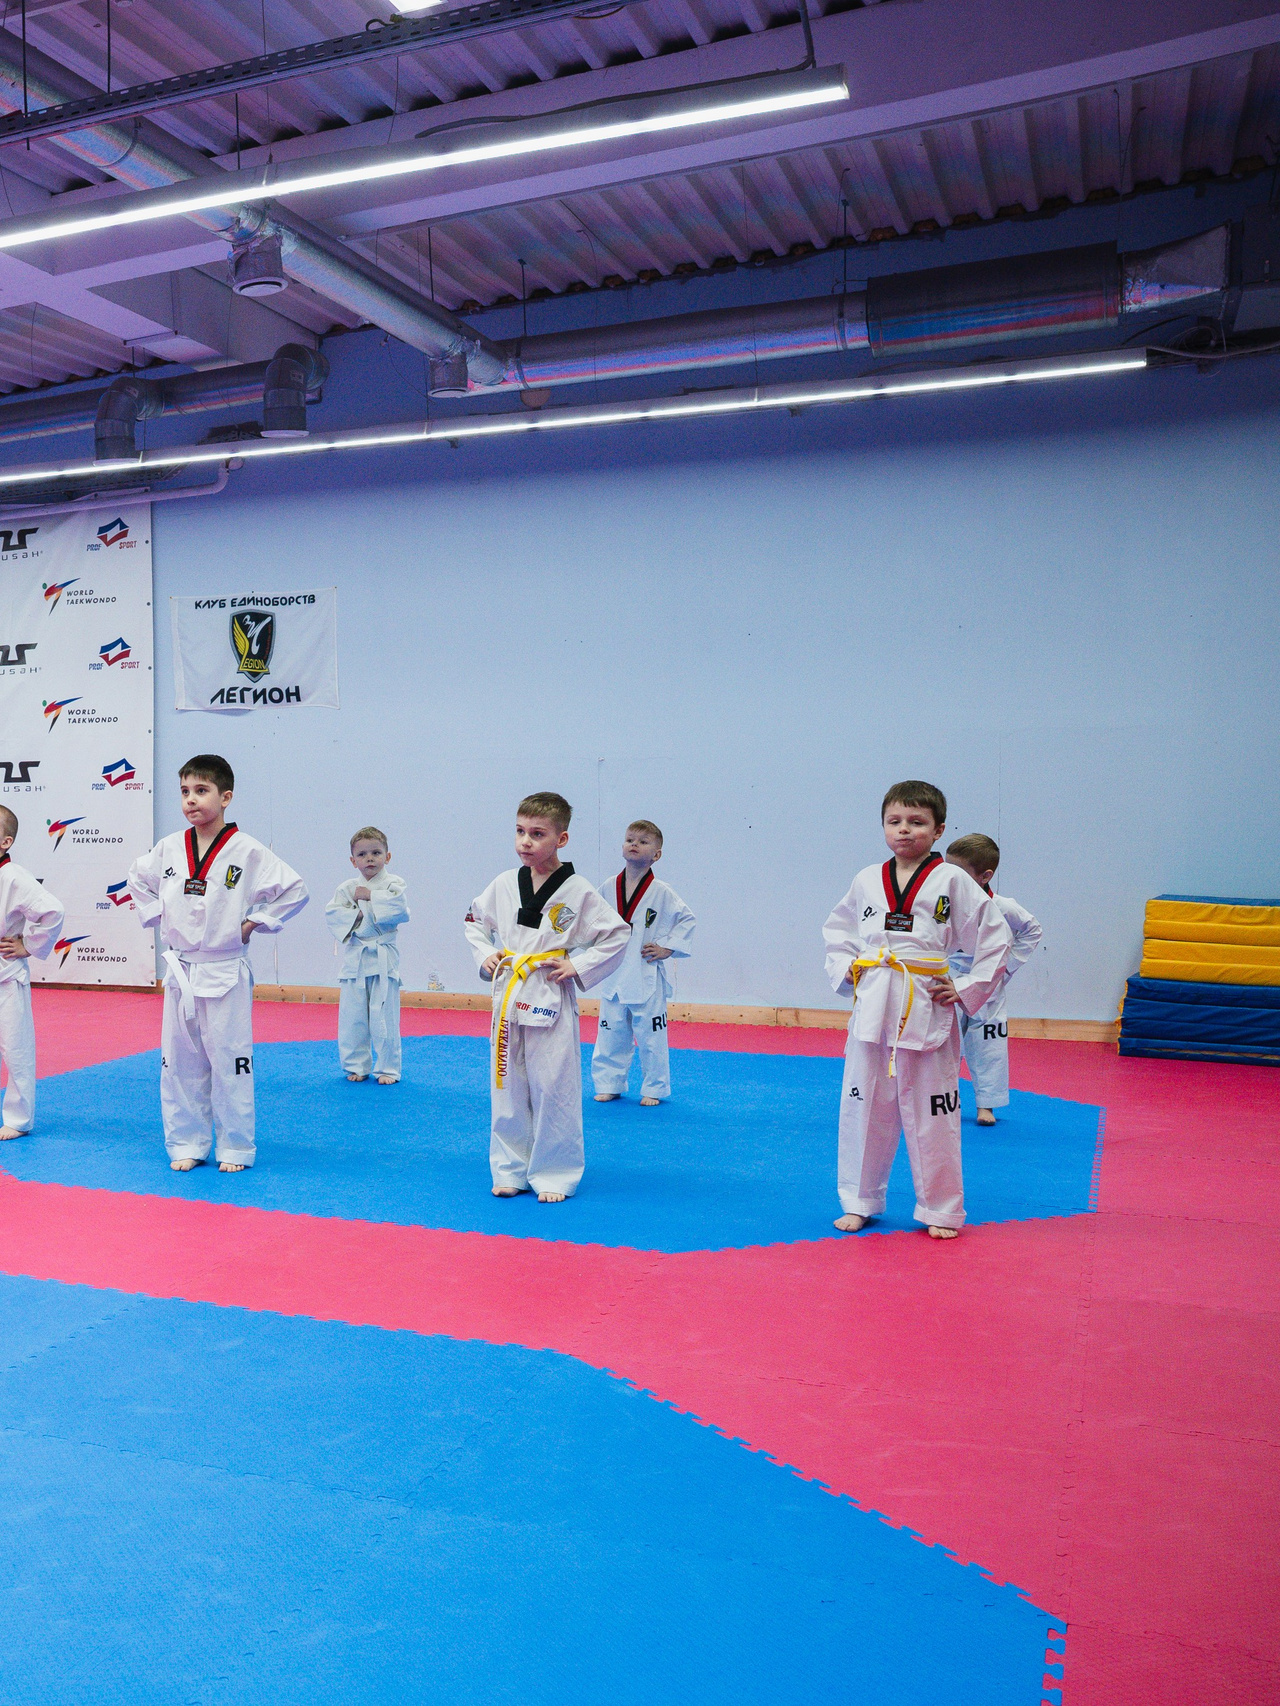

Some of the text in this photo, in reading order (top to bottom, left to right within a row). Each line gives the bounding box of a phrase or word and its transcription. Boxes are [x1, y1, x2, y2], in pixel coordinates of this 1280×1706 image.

[66, 597, 116, 605] TAEKWONDO
[195, 594, 315, 609] КЛУБ ЕДИНОБОРСТВ
[210, 686, 301, 704] ЛЕГИОН
[532, 1006, 557, 1018] SPORT
[931, 1091, 961, 1116] RU
